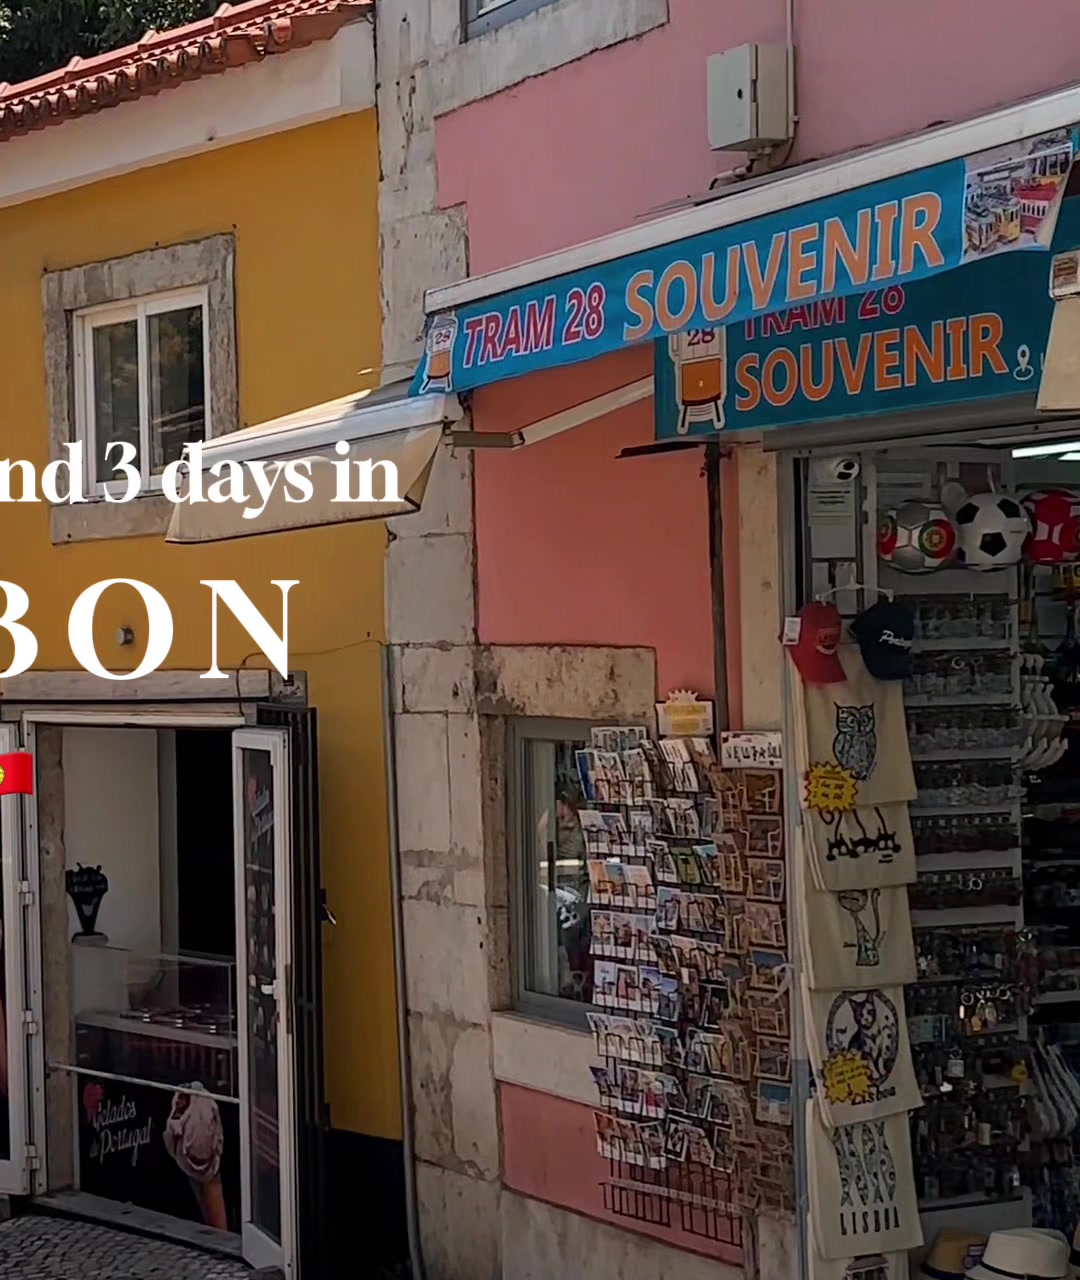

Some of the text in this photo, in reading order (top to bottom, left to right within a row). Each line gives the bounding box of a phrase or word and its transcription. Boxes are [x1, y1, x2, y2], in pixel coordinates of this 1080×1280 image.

[462, 191, 945, 368] TRAM 28 SOUVENIR
[686, 327, 716, 347] 28
[734, 312, 1010, 412] SOUVENIR
